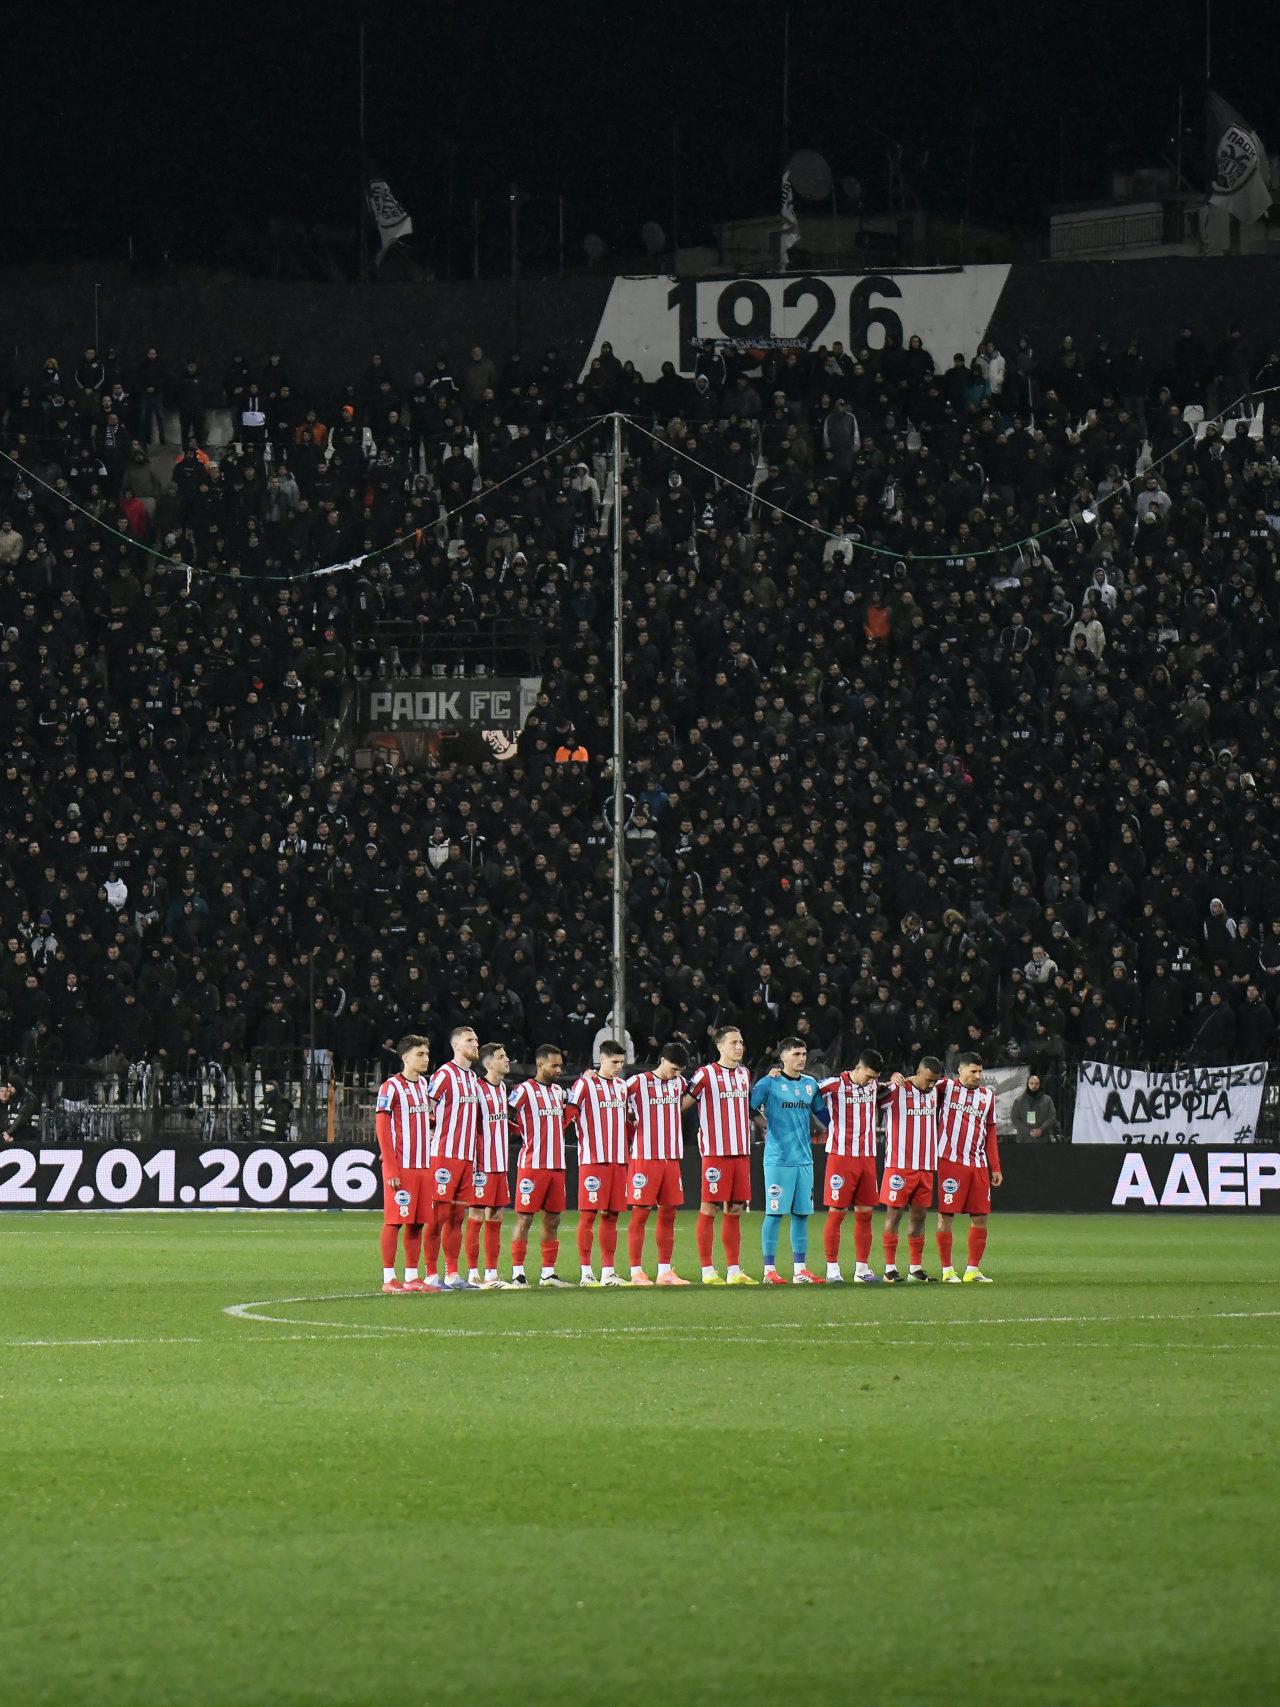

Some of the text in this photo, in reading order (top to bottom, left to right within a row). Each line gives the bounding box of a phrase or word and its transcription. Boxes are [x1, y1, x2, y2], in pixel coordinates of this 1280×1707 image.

[668, 274, 903, 372] 1926
[371, 690, 511, 720] PAOK FC
[1078, 1062, 1132, 1089] ΚΑΛΟ
[949, 1101, 984, 1118] novibet
[1103, 1088, 1231, 1124] ΑΔΕΡΦΙΑ
